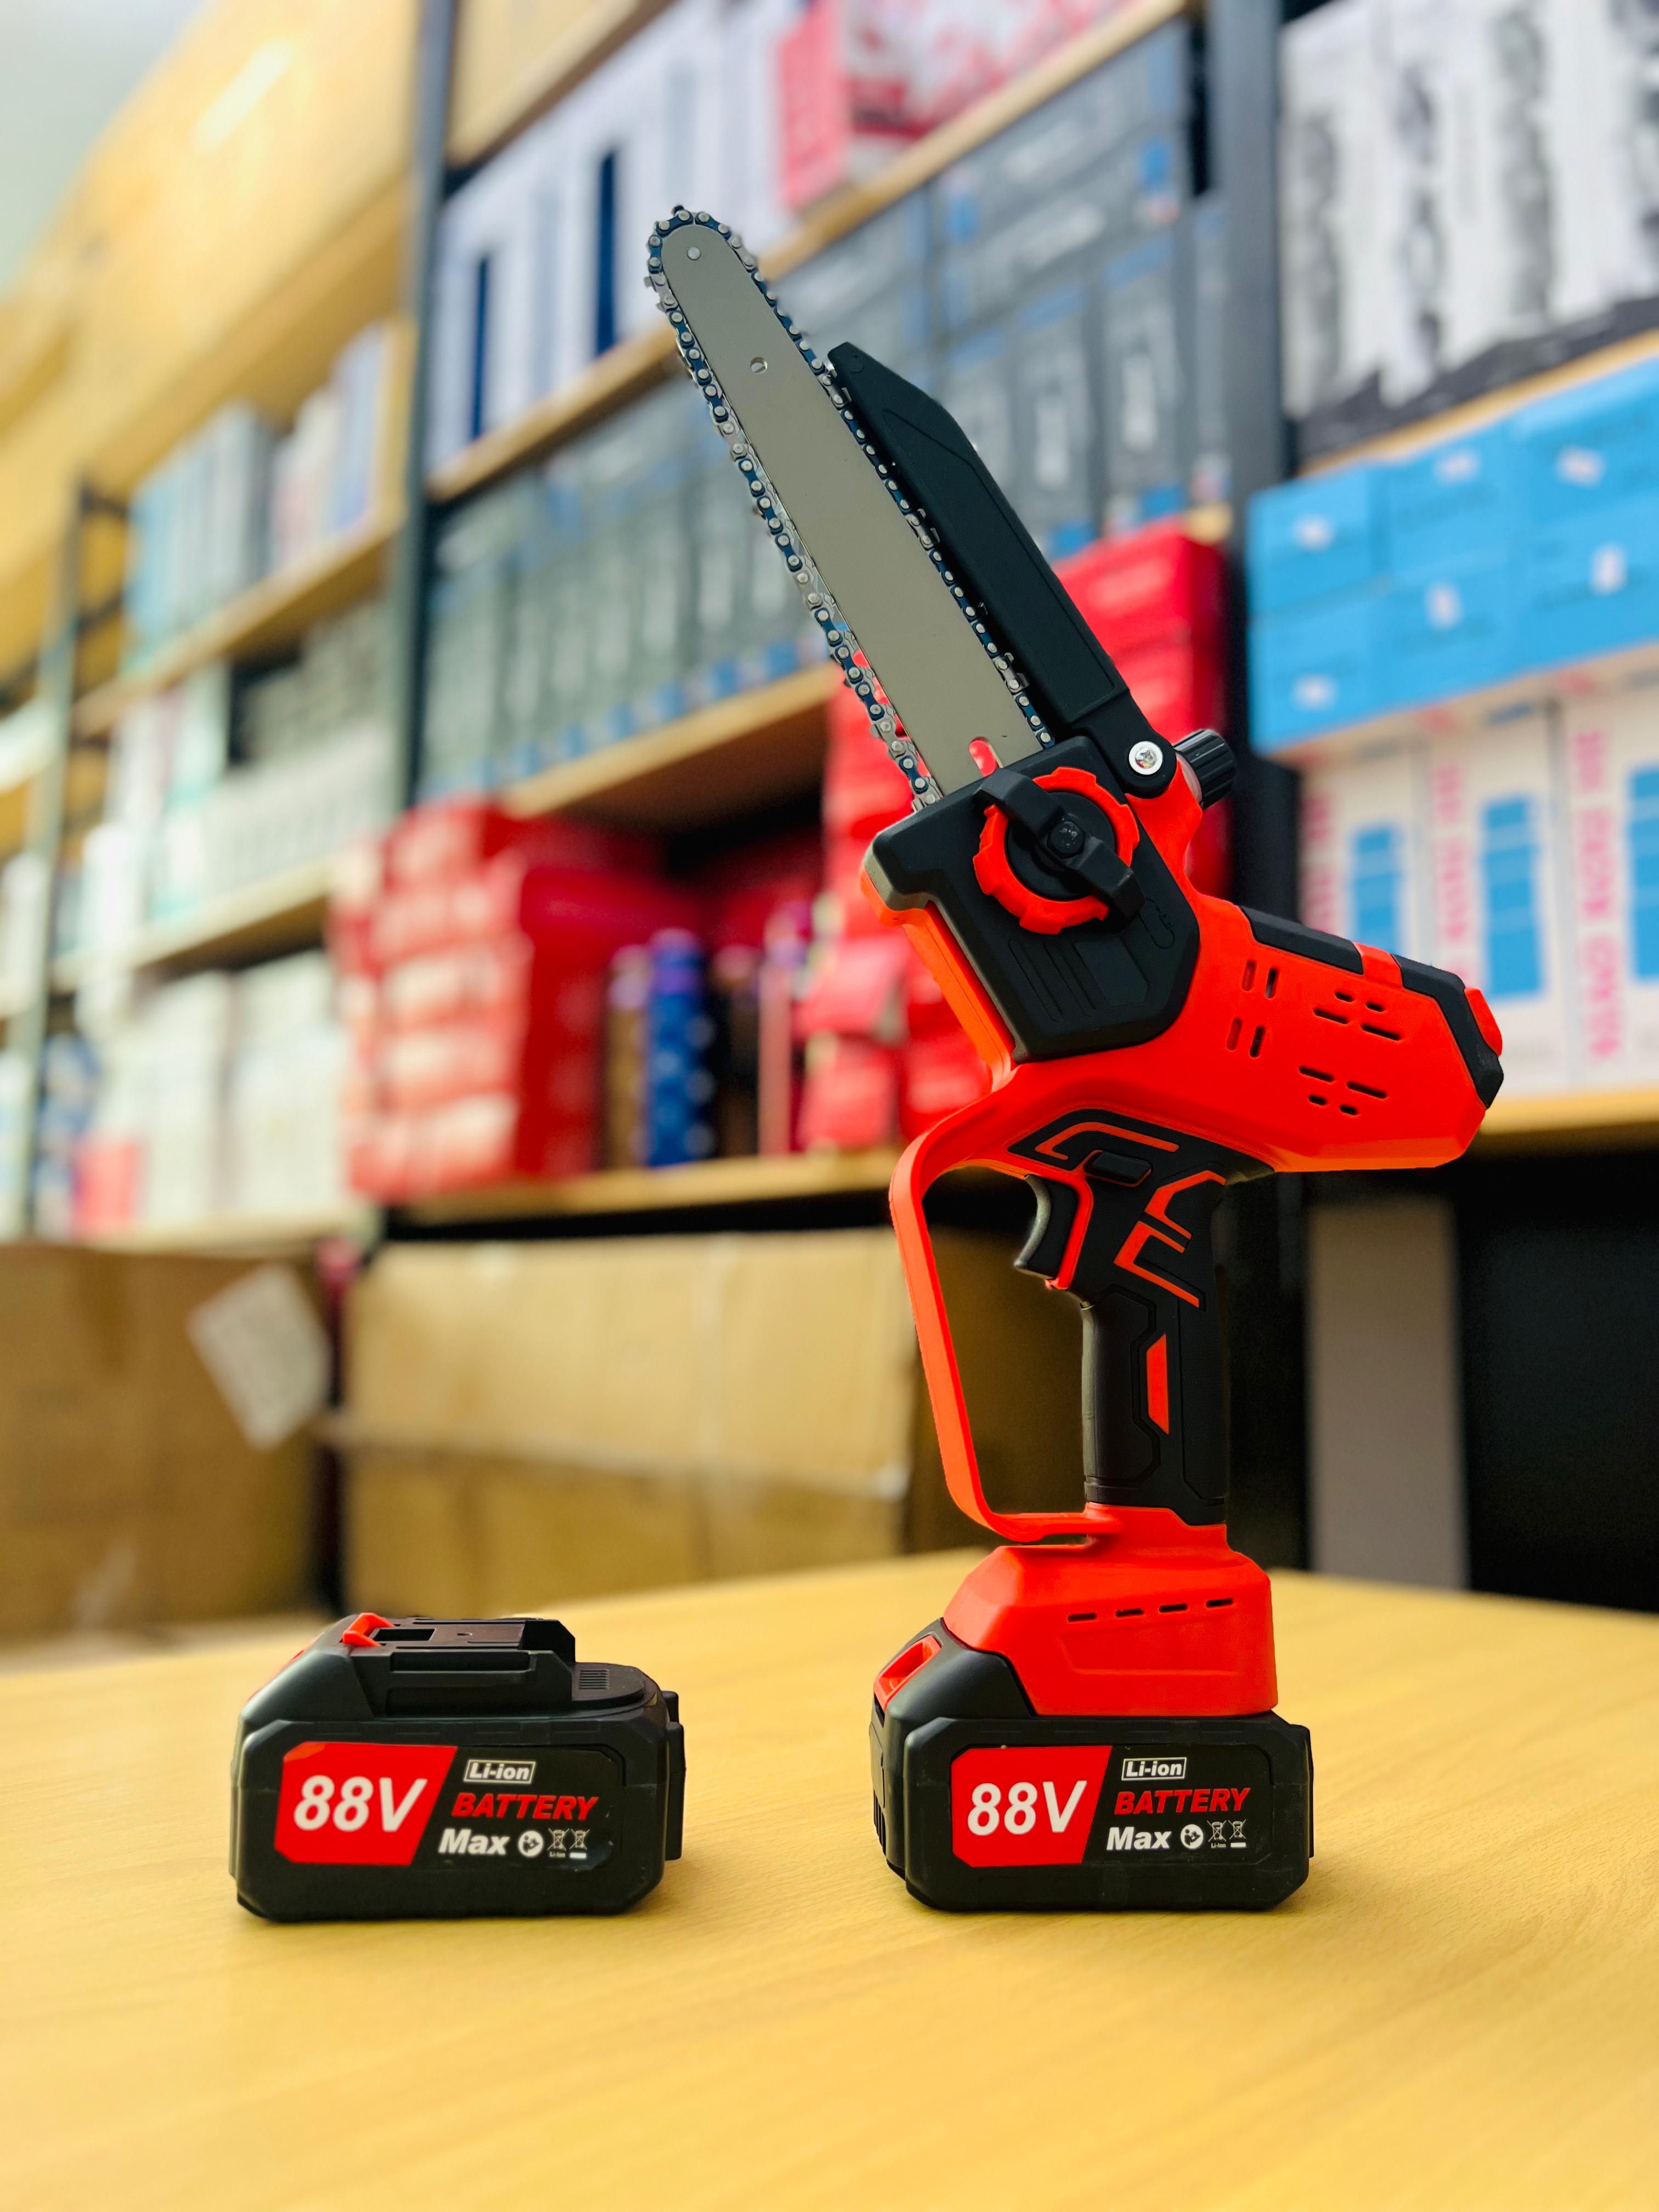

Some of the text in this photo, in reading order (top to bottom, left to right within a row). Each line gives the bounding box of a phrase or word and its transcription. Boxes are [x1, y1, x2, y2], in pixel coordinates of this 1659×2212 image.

[469, 1762, 530, 1780] Li-ion
[1126, 1760, 1182, 1777] Li-ion
[294, 1775, 428, 1832] 88V
[451, 1792, 599, 1820] BATTERY
[967, 1780, 1087, 1836] 88V
[1114, 1787, 1251, 1815] BATTERY
[438, 1828, 510, 1856] Max
[1106, 1826, 1172, 1851] Max
